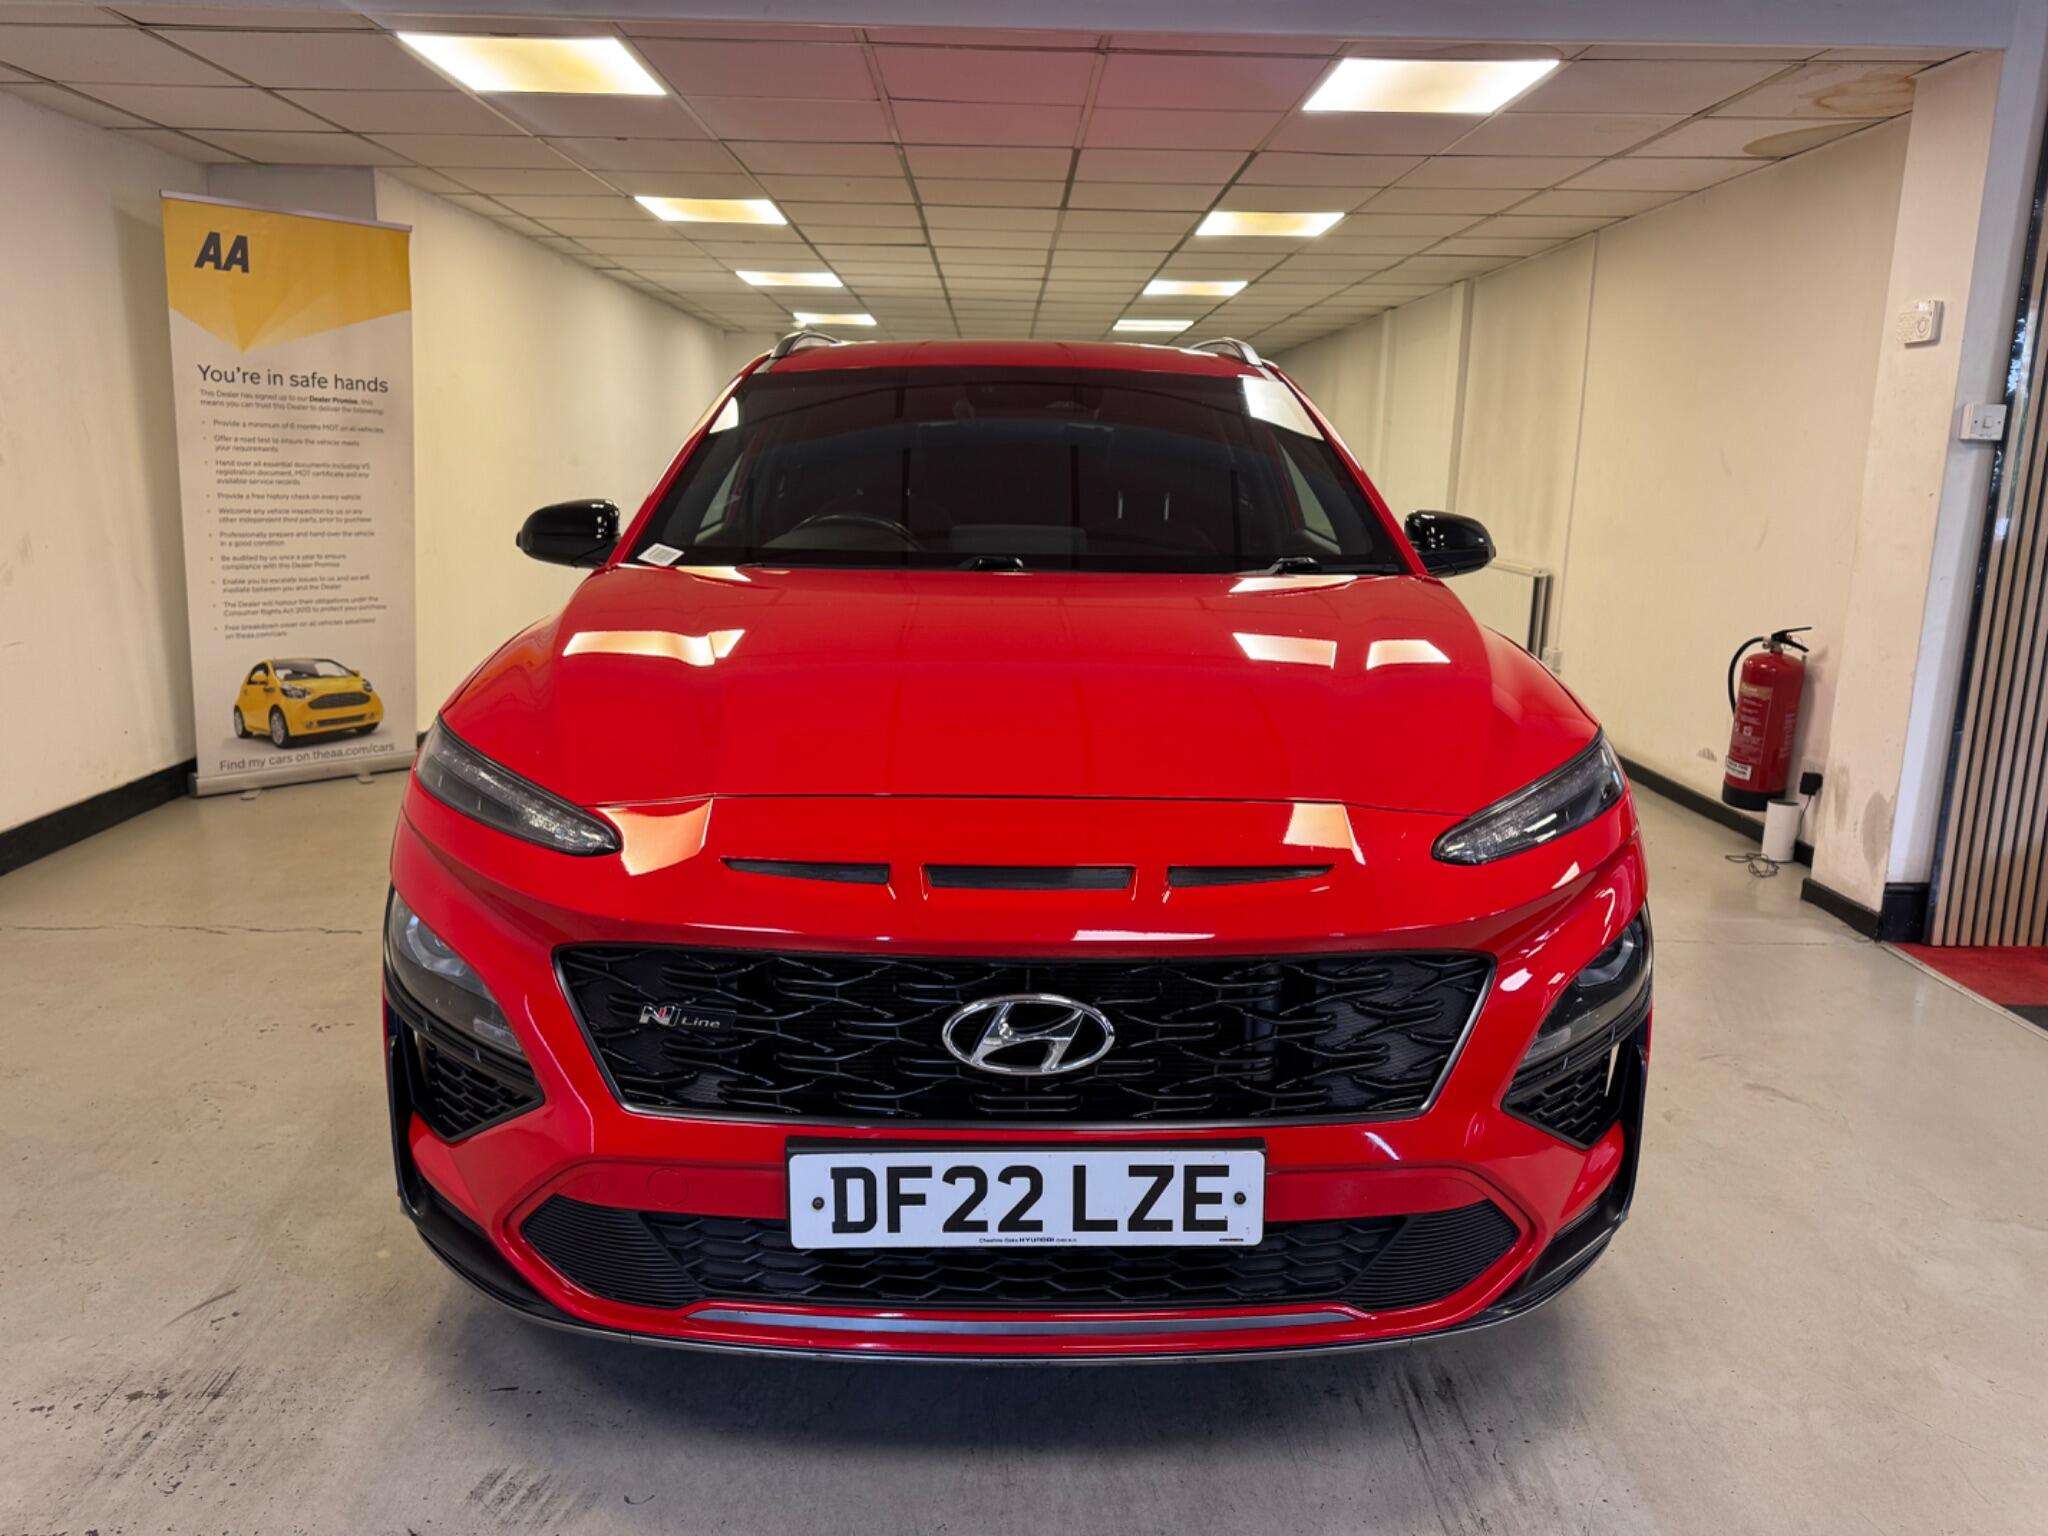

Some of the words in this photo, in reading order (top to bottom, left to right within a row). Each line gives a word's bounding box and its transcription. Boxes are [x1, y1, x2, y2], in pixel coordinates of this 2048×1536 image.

[194, 231, 249, 273] AA
[197, 364, 261, 385] You're
[267, 369, 284, 386] in
[289, 371, 328, 389] safe
[334, 374, 389, 393] hands
[309, 395, 331, 403] Dealer
[219, 759, 245, 772] Find
[249, 758, 266, 770] my
[268, 755, 293, 766] cars
[295, 752, 310, 763] on
[312, 742, 395, 761] theaa.com/cars
[681, 1015, 720, 1028] Line
[830, 1165, 1044, 1234] DF22
[1072, 1165, 1230, 1233] LZE
